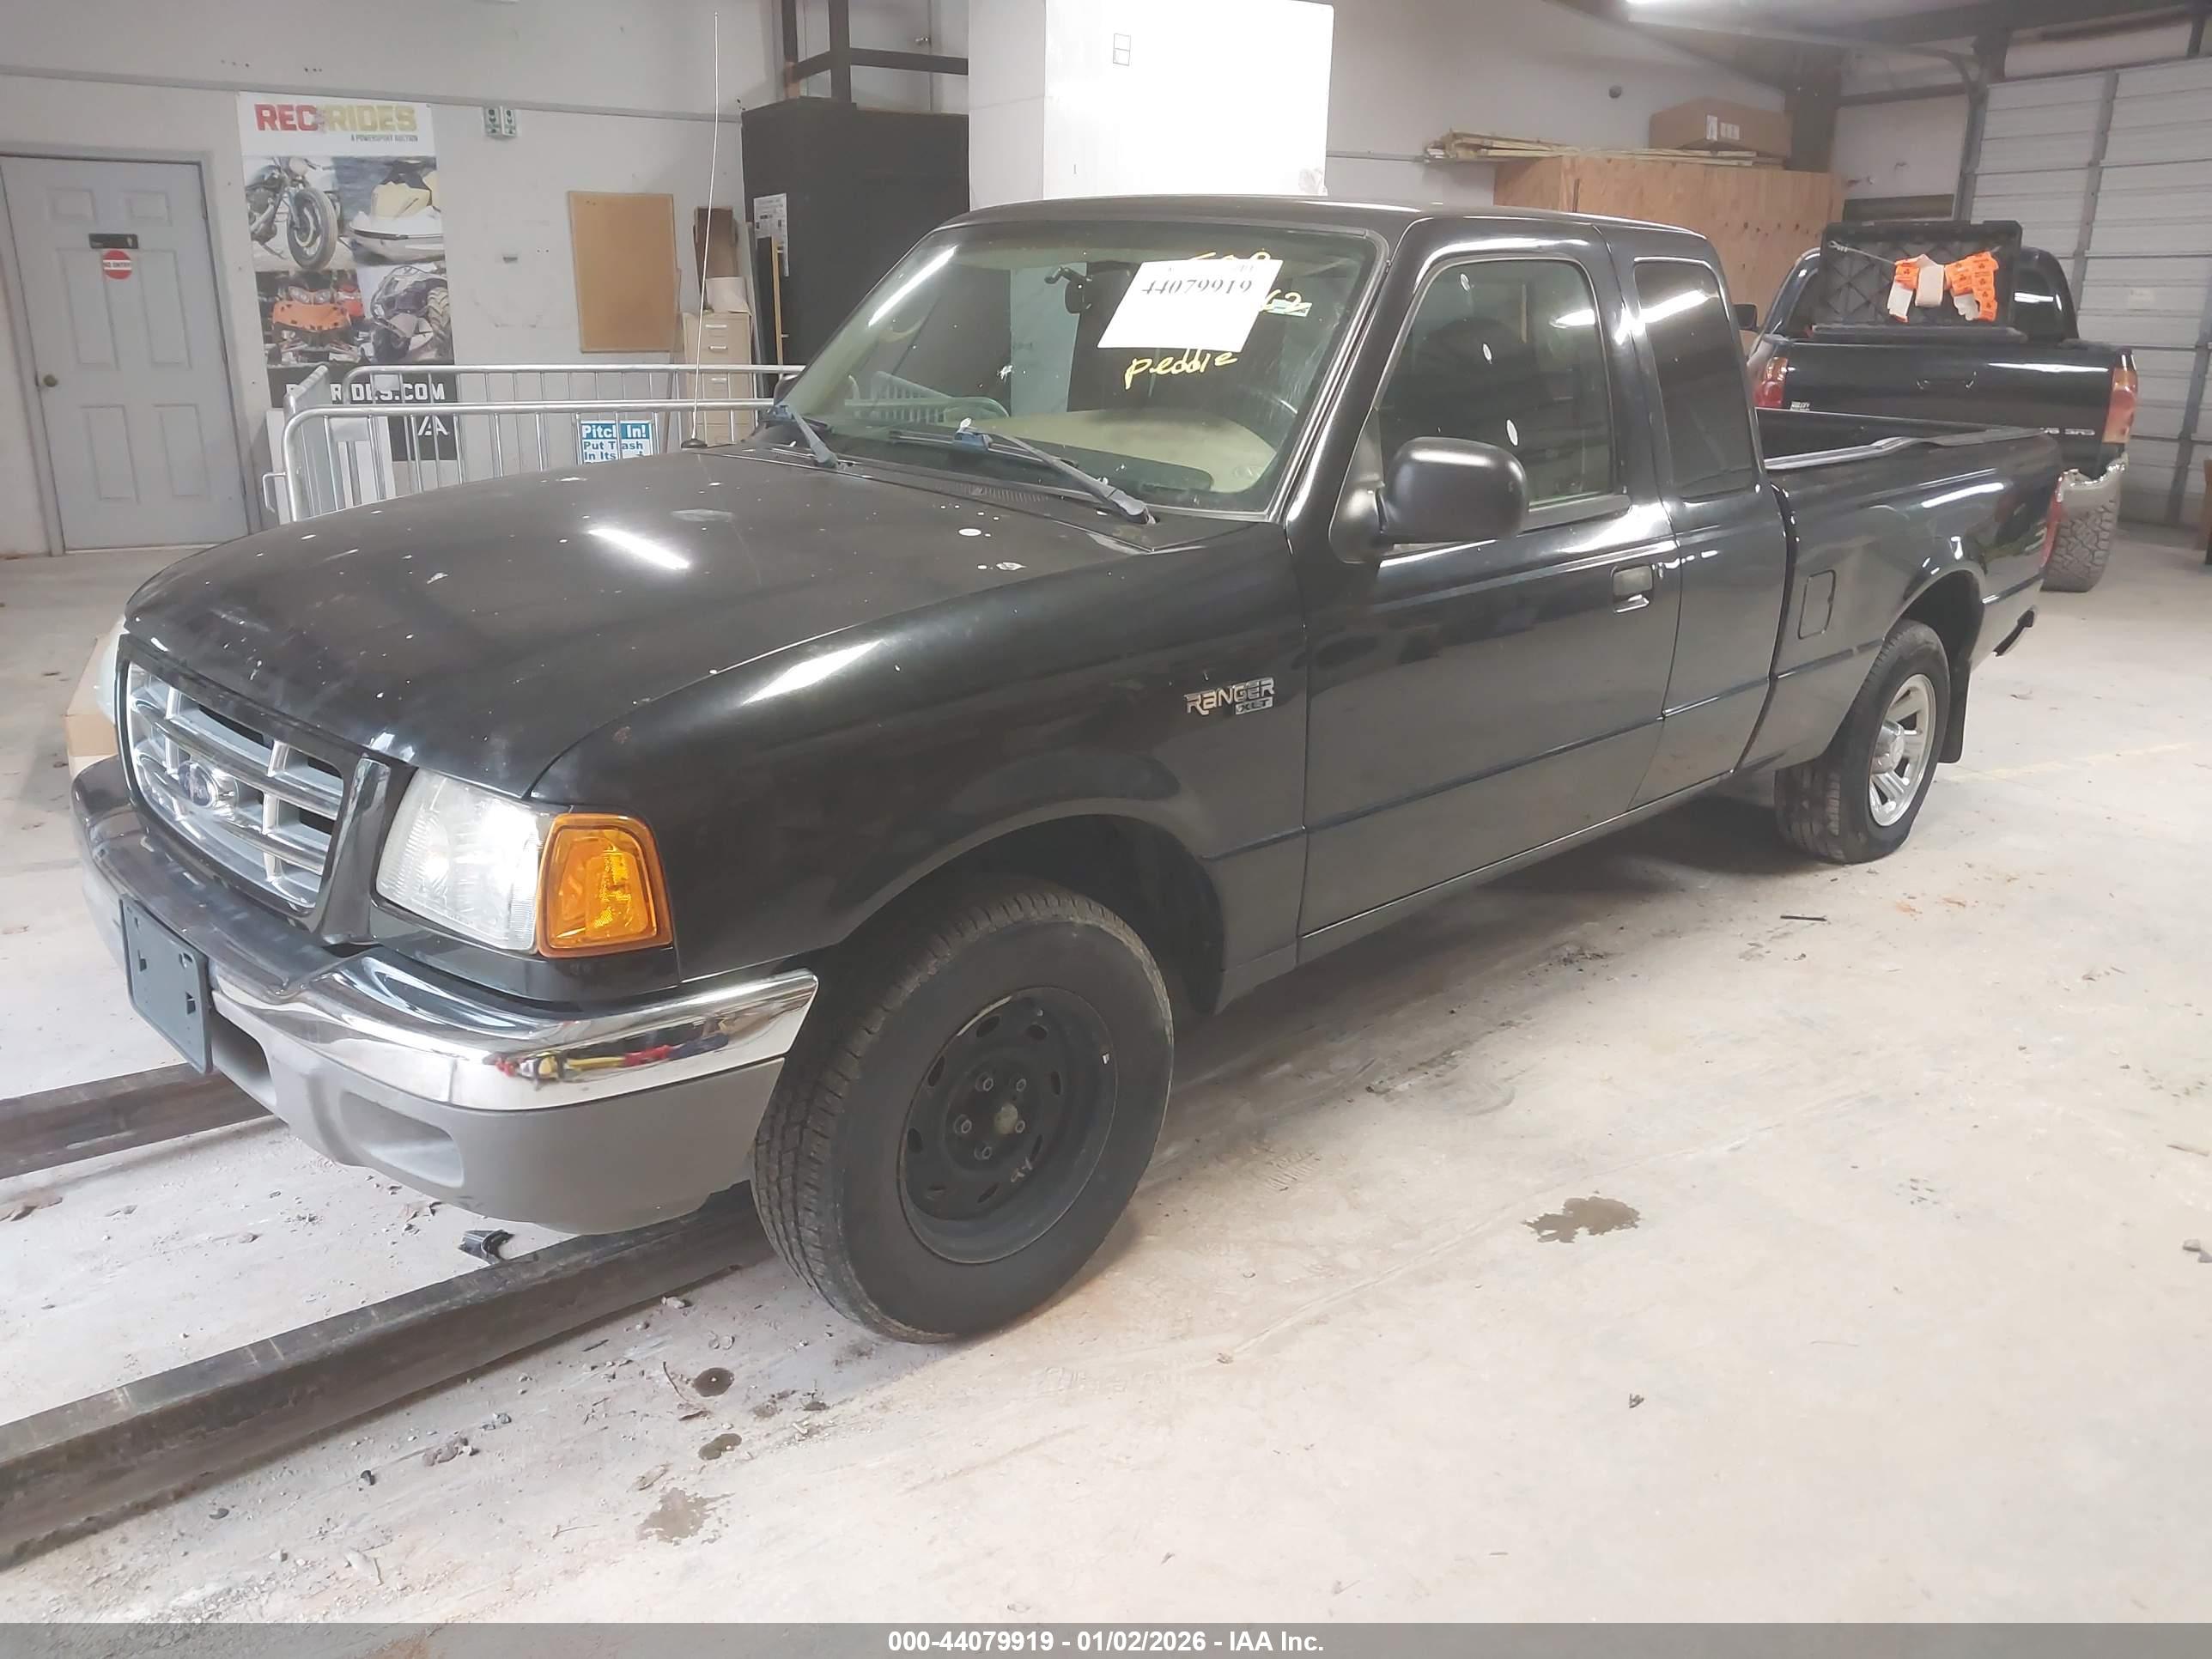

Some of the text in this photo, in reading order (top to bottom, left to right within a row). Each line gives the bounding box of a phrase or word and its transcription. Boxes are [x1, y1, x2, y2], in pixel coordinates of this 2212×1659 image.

[1141, 279, 1253, 295] 44079919
[626, 424, 647, 438] In!
[584, 441, 643, 450] Put Tash
[584, 452, 617, 460] In Its
[1237, 697, 1272, 713] XLT
